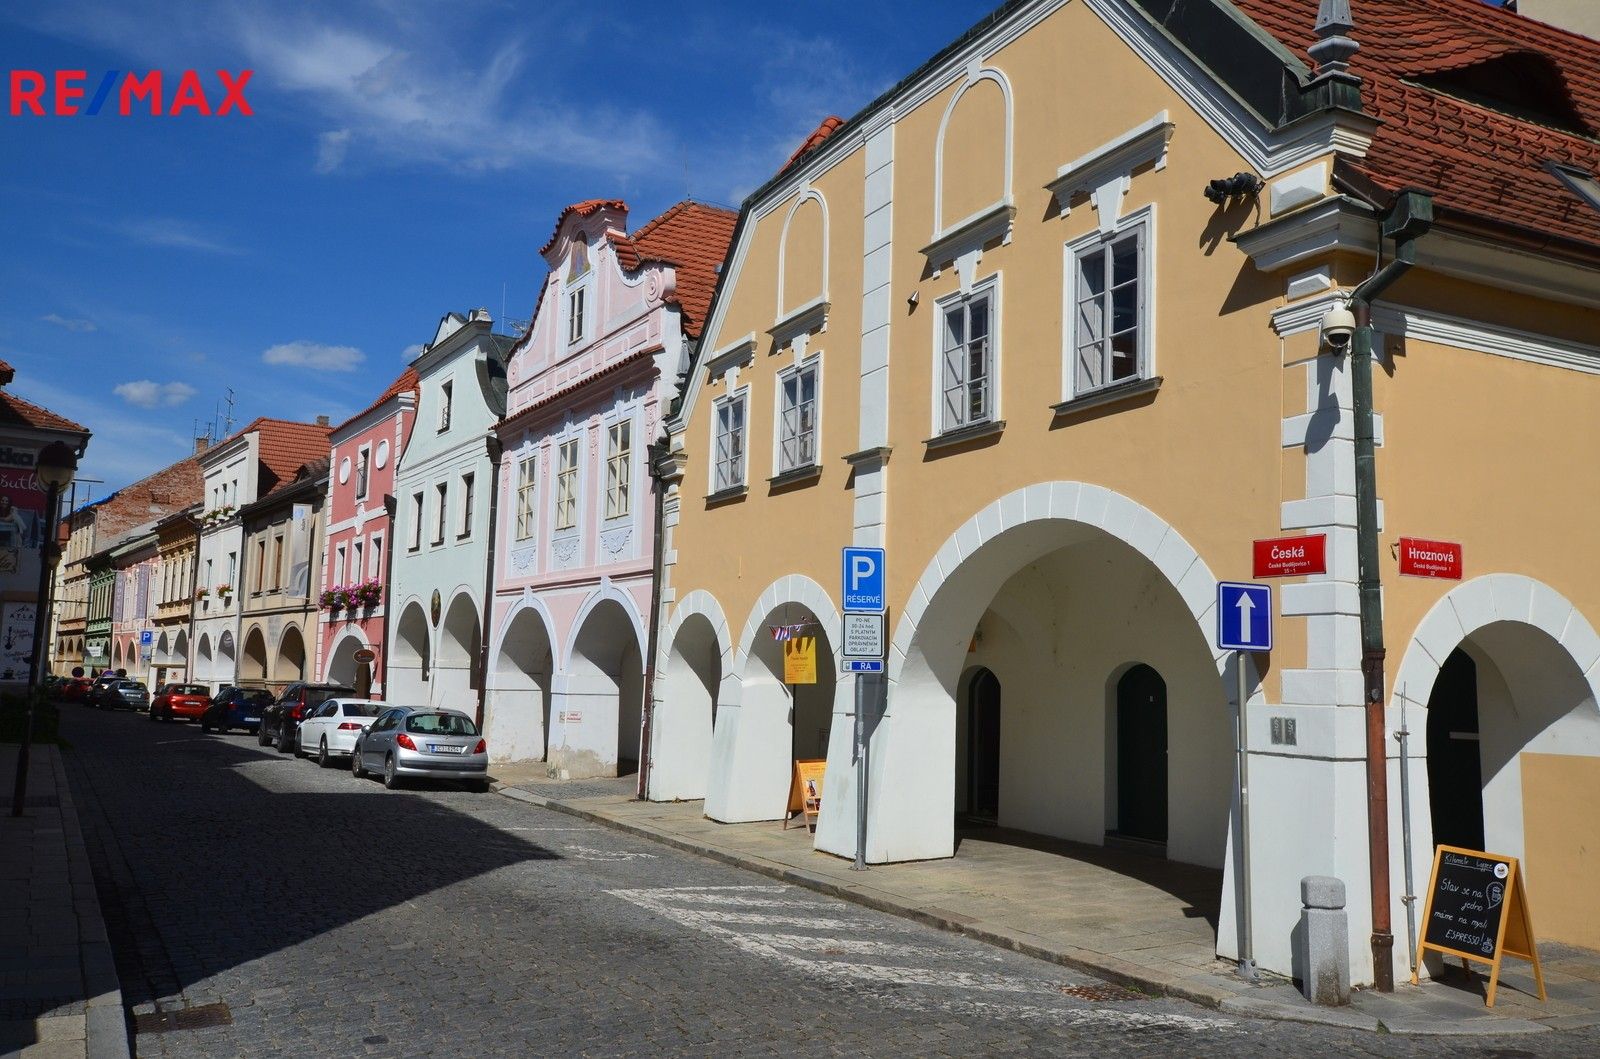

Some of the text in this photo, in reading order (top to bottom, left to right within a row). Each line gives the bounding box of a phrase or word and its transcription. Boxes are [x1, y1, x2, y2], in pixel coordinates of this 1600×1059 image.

[1271, 545, 1305, 560] Česká
[1408, 547, 1454, 563] Hroznová
[852, 556, 875, 590] P
[143, 632, 150, 640] P
[860, 662, 872, 670] RA
[1440, 878, 1483, 898] Stav se na
[1460, 901, 1483, 911] jedno
[1434, 910, 1454, 920] máme
[1445, 929, 1485, 946] ESPRESSO!
